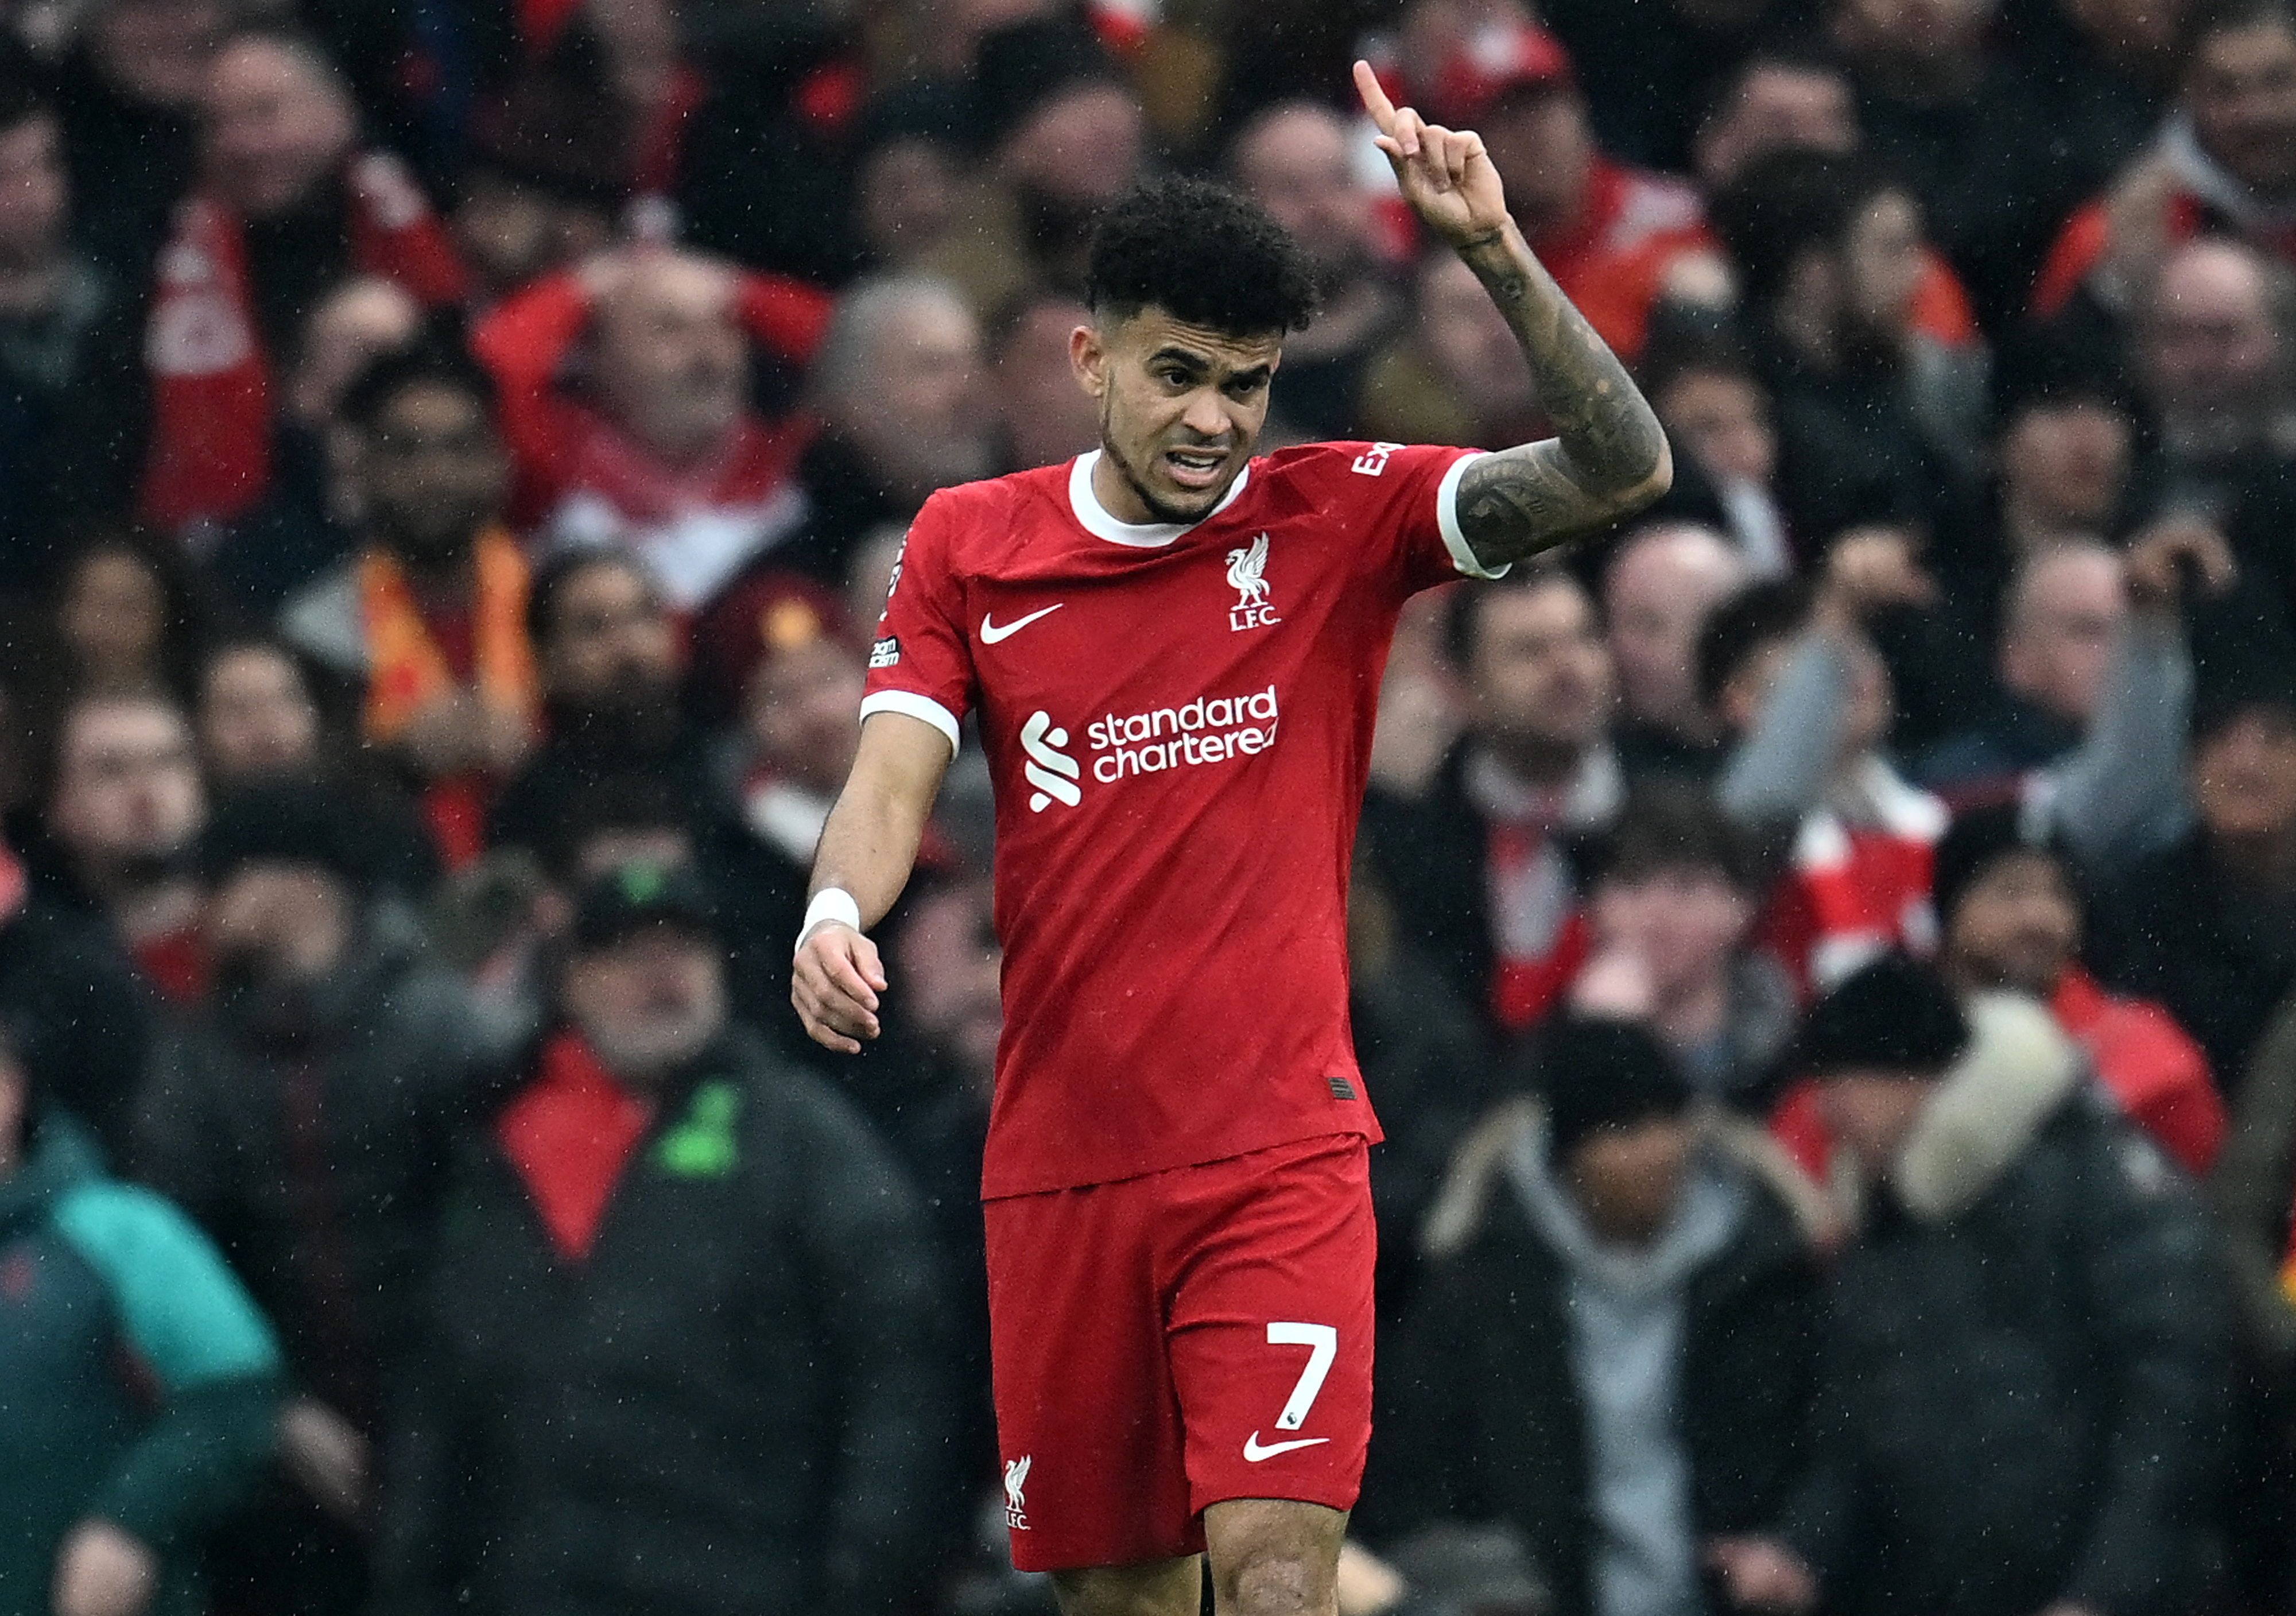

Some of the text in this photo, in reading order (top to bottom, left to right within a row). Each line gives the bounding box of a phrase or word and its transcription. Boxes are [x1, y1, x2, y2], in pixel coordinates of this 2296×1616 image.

[1088, 684, 1278, 750] standard
[1093, 717, 1279, 783] chartered
[1267, 1322, 1337, 1430] 7
